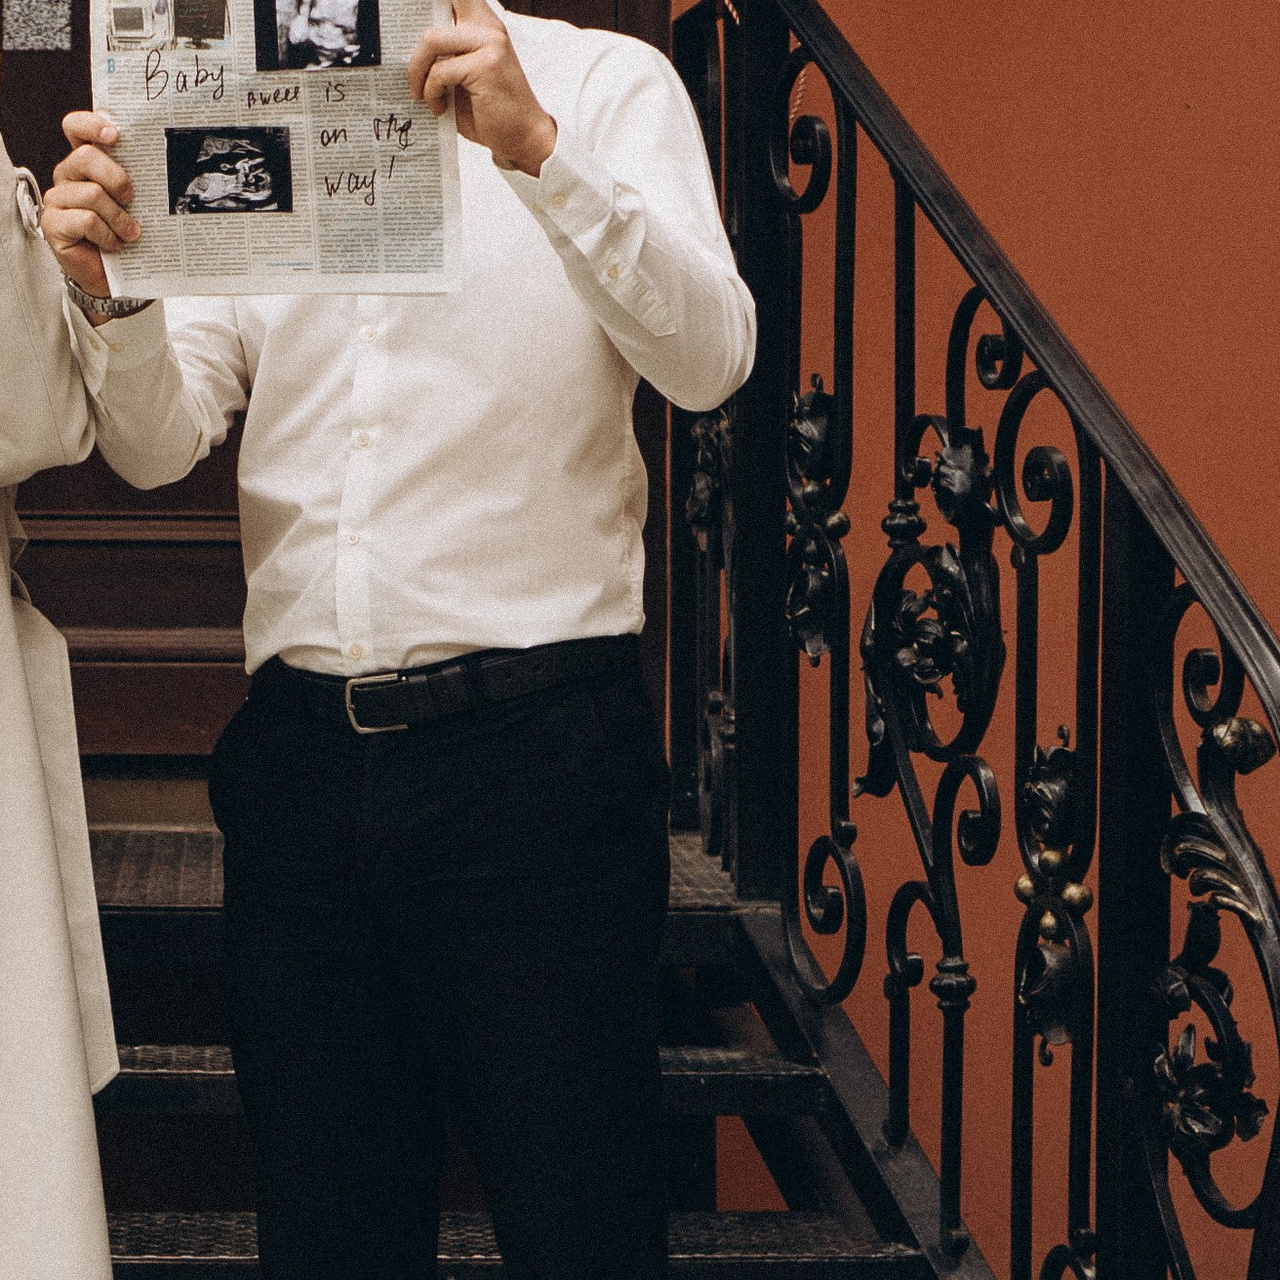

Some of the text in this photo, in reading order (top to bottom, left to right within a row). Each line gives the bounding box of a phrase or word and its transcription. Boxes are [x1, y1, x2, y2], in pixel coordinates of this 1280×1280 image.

[146, 49, 224, 101] Baby
[326, 81, 346, 102] is
[320, 128, 348, 147] on
